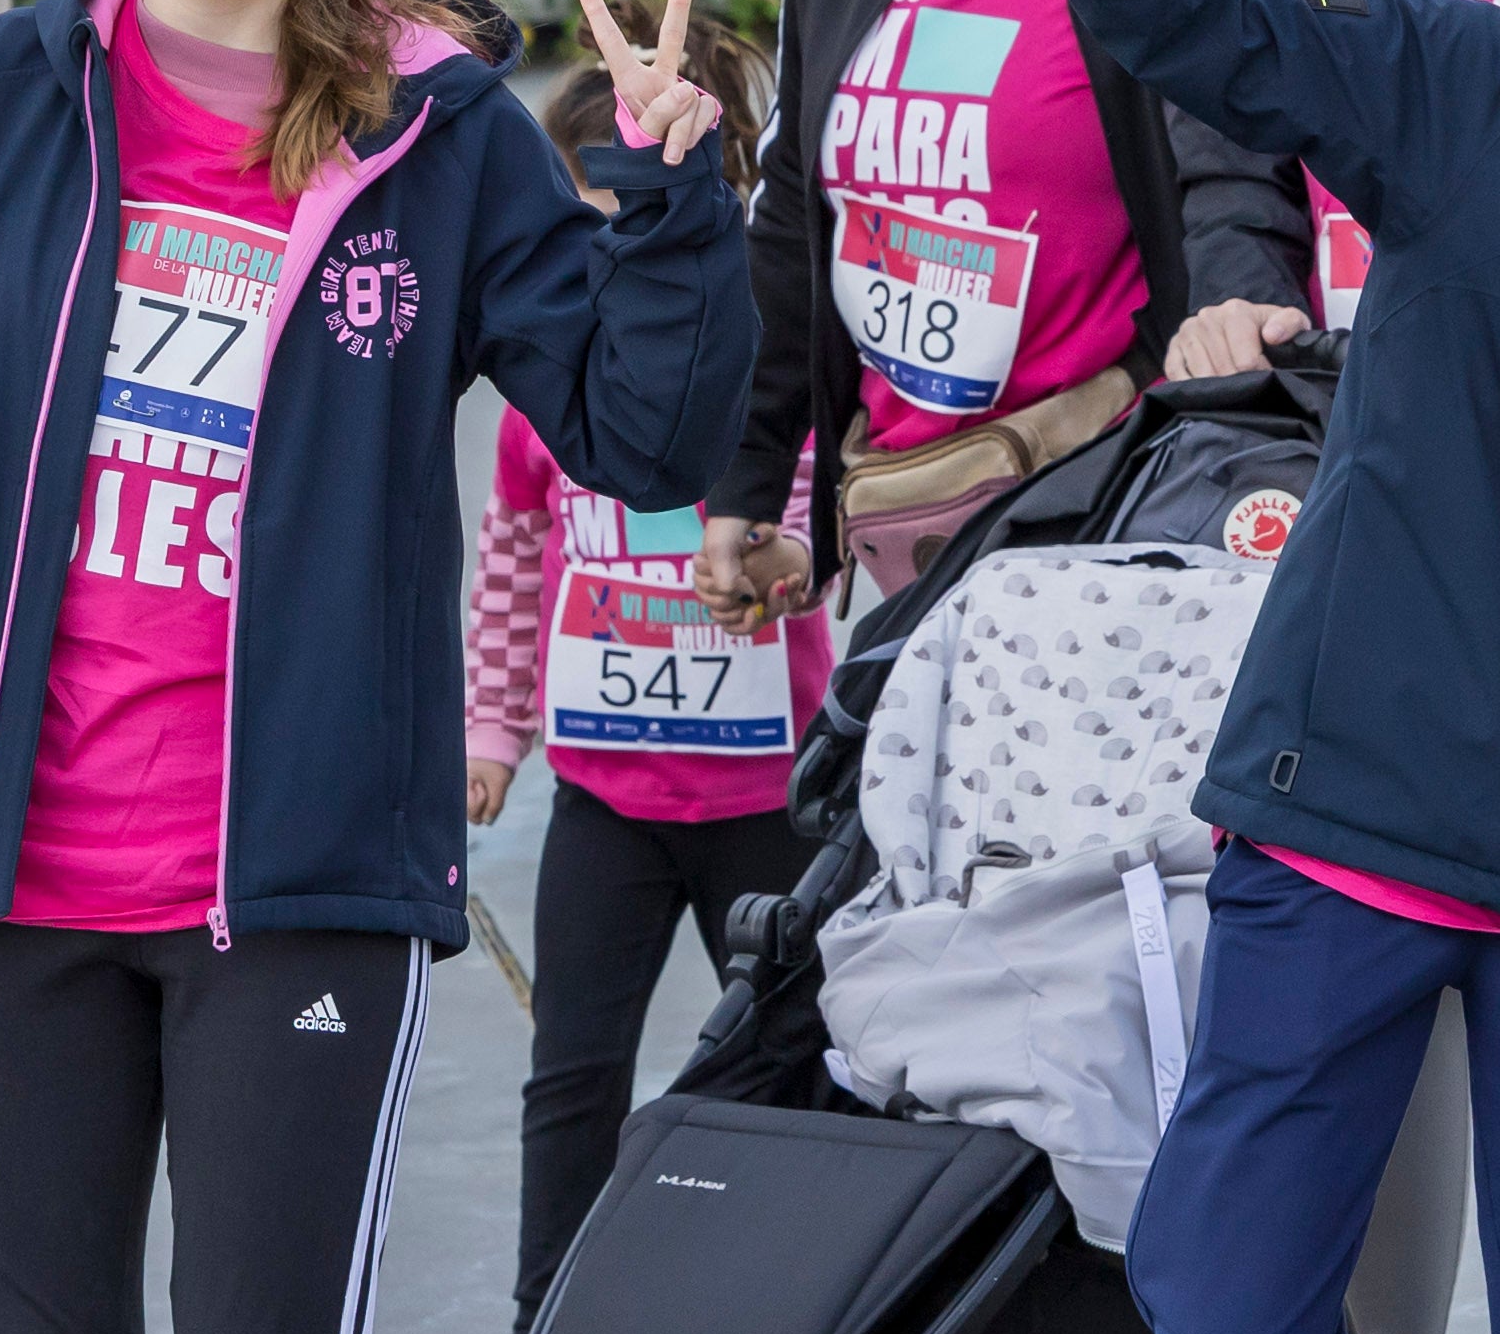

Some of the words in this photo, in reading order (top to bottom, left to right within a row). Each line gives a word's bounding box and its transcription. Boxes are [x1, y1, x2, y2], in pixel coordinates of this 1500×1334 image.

[820, 92, 992, 193] PARA
[124, 220, 158, 255] VI
[904, 233, 997, 275] MARCHA
[153, 258, 170, 272] DE
[171, 264, 186, 276] LA
[320, 257, 348, 303] GIRL
[915, 265, 993, 305] MUJER
[862, 278, 960, 364] 318
[70, 469, 242, 598] LES
[620, 592, 642, 622] VI
[598, 649, 732, 713] 547
[293, 1016, 347, 1034] adidas
